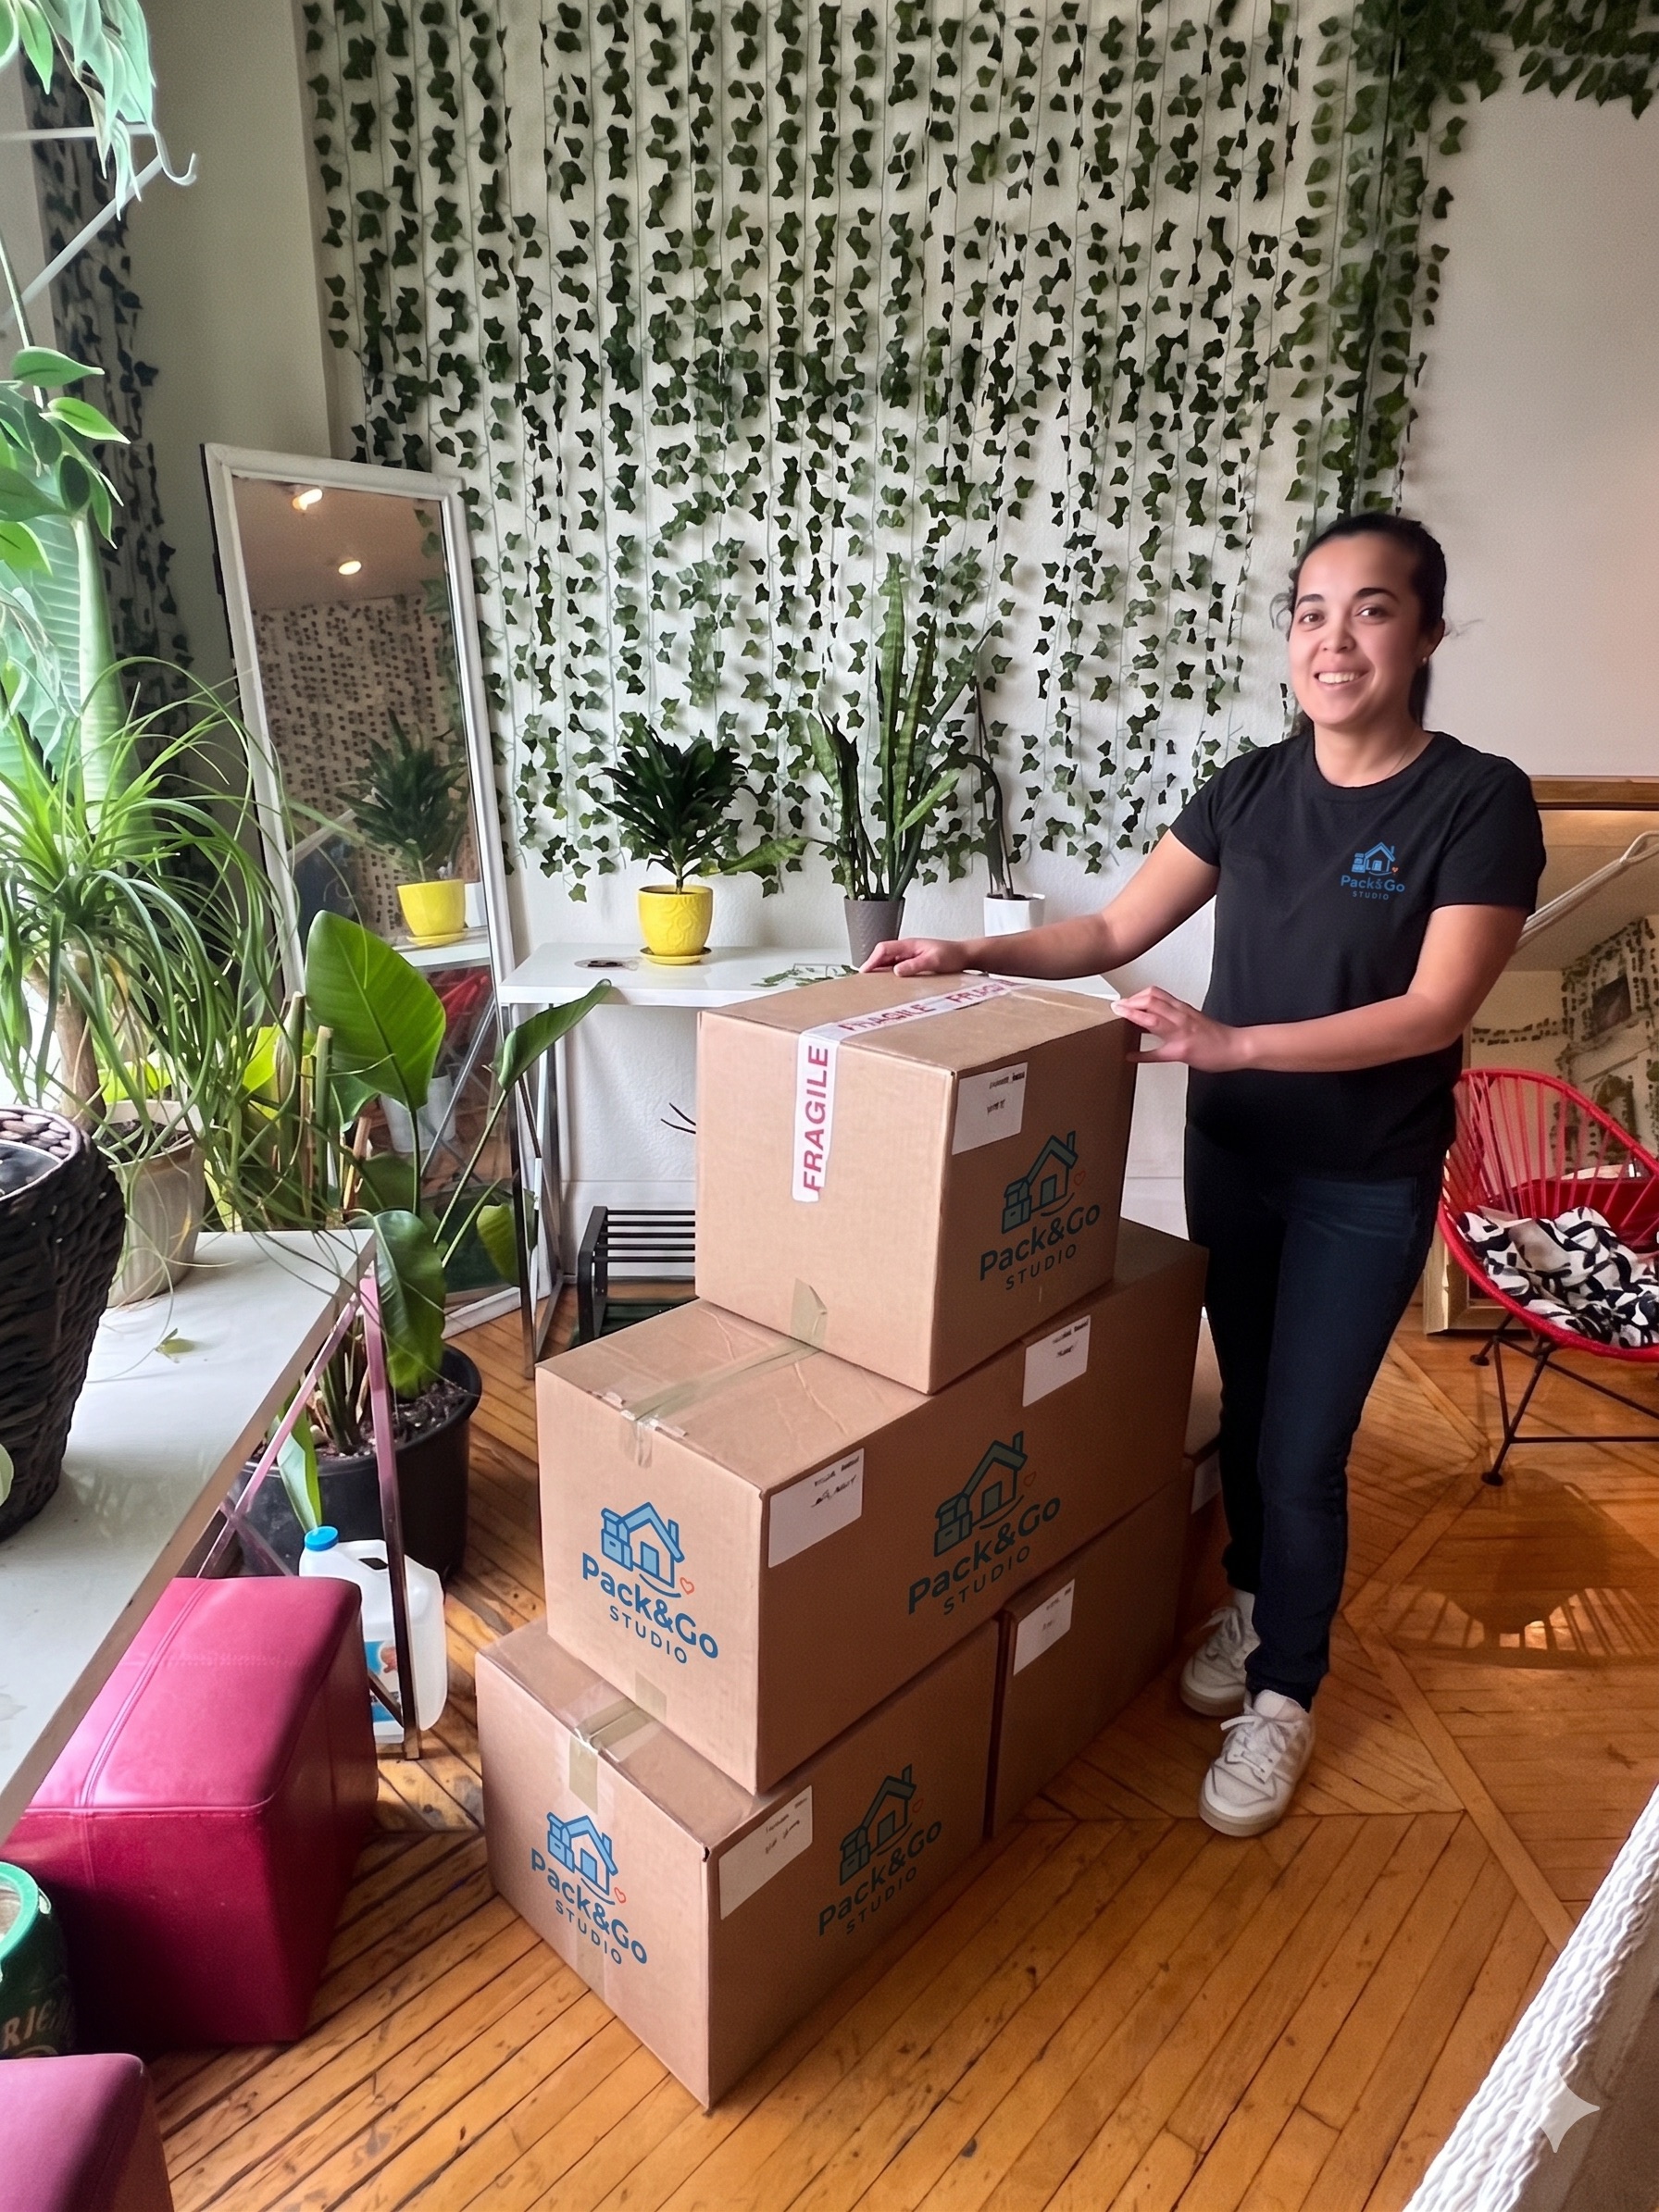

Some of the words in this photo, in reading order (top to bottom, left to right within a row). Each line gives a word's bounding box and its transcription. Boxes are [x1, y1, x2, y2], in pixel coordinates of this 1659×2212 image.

[1341, 875, 1405, 892] Pack&Go
[1352, 890, 1390, 901] STUDIO
[803, 1045, 829, 1192] FRAGILE
[979, 1201, 1102, 1282] Pack&Go
[1004, 1244, 1078, 1291] STUDIO
[907, 1496, 1061, 1616] Pack&Go
[943, 1546, 1031, 1617] STUDIO
[581, 1552, 719, 1660] Pack&Go
[608, 1605, 688, 1665] STUDIO
[530, 1845, 648, 1967] Pack&Go
[818, 1819, 942, 1937] Pack&Go
[845, 1866, 917, 1935] STUDIO
[555, 1898, 622, 1966] STUDIO
